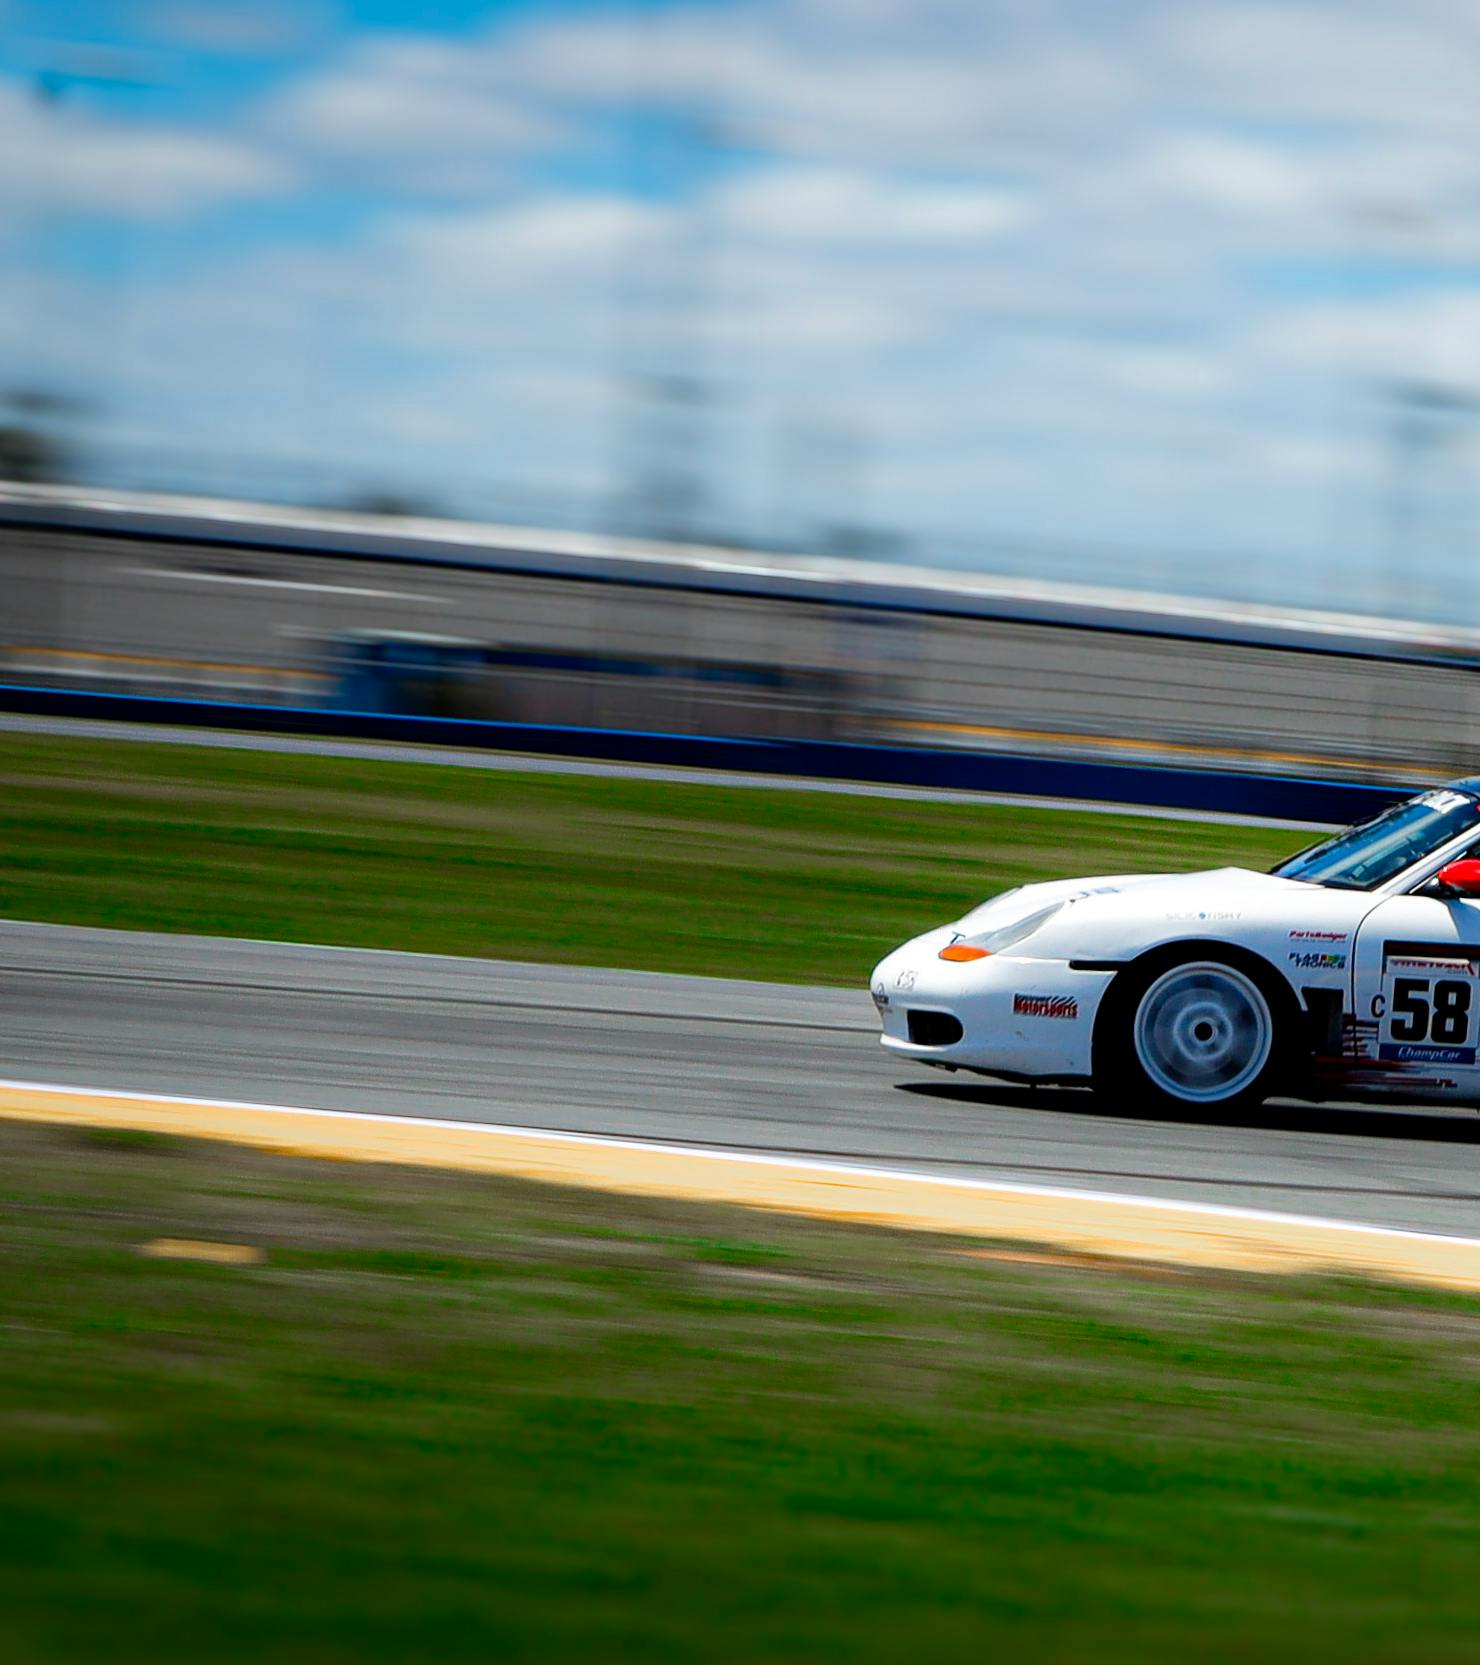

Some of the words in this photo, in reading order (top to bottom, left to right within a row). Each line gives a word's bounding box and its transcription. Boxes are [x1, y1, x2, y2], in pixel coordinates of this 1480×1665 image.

[1371, 994, 1386, 1018] C
[1391, 978, 1471, 1044] 58
[1398, 1046, 1461, 1060] ChampCar
